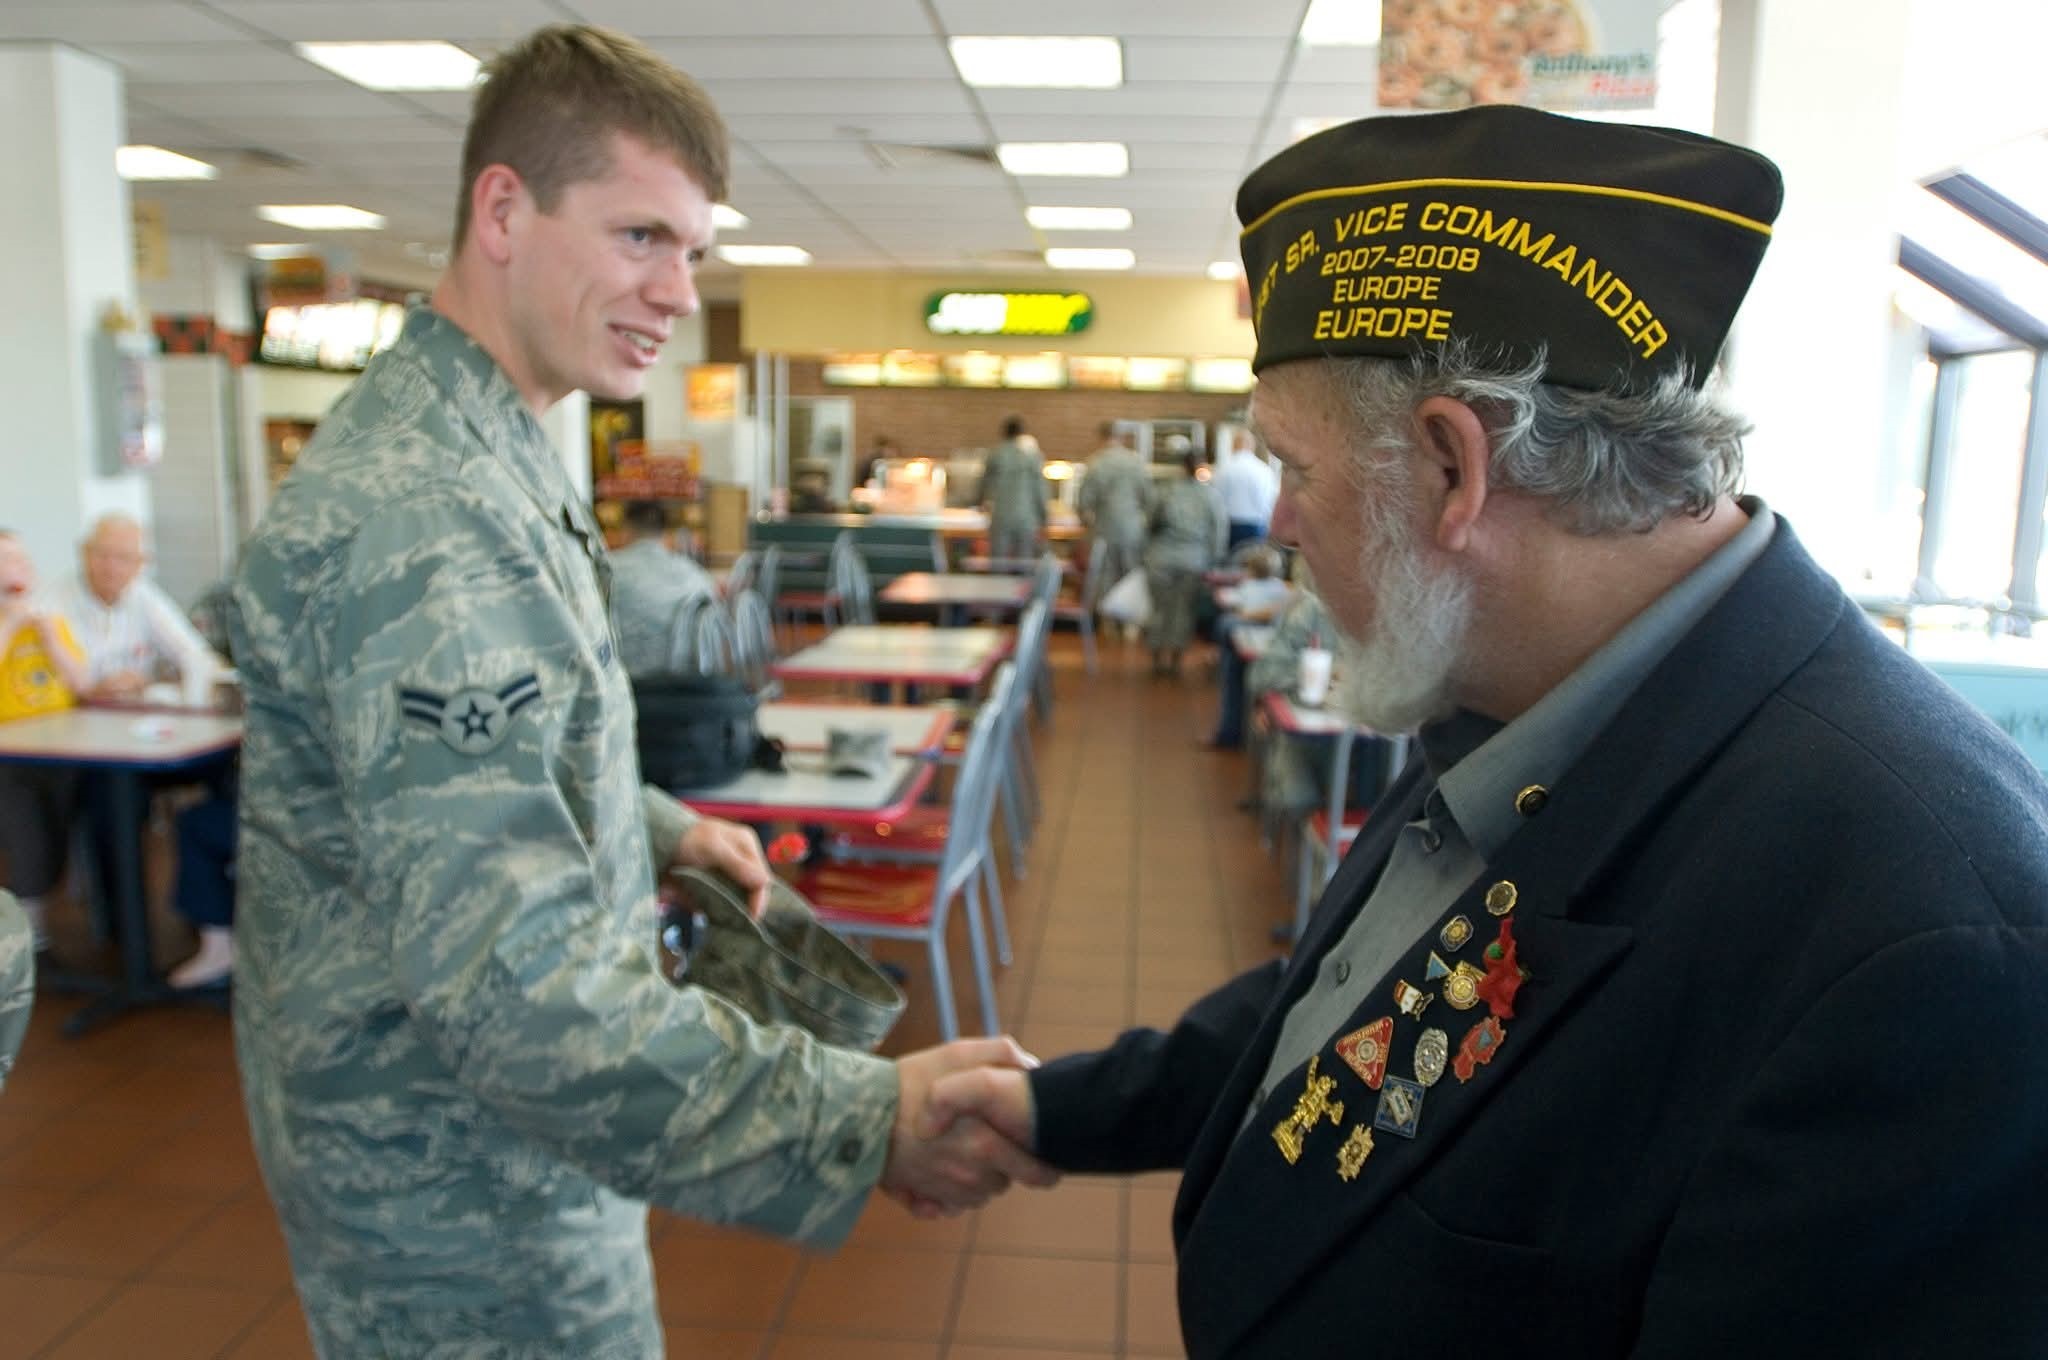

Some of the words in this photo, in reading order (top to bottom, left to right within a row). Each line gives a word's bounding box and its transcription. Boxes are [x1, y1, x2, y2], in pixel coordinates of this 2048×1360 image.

[1320, 244, 1480, 276] 2007-2008
[1285, 229, 1320, 274] SR.
[1335, 202, 1409, 243] VICE
[1419, 201, 1669, 359] COMMANDER
[1333, 275, 1441, 303] EUROPE
[1314, 307, 1453, 341] EUROPE
